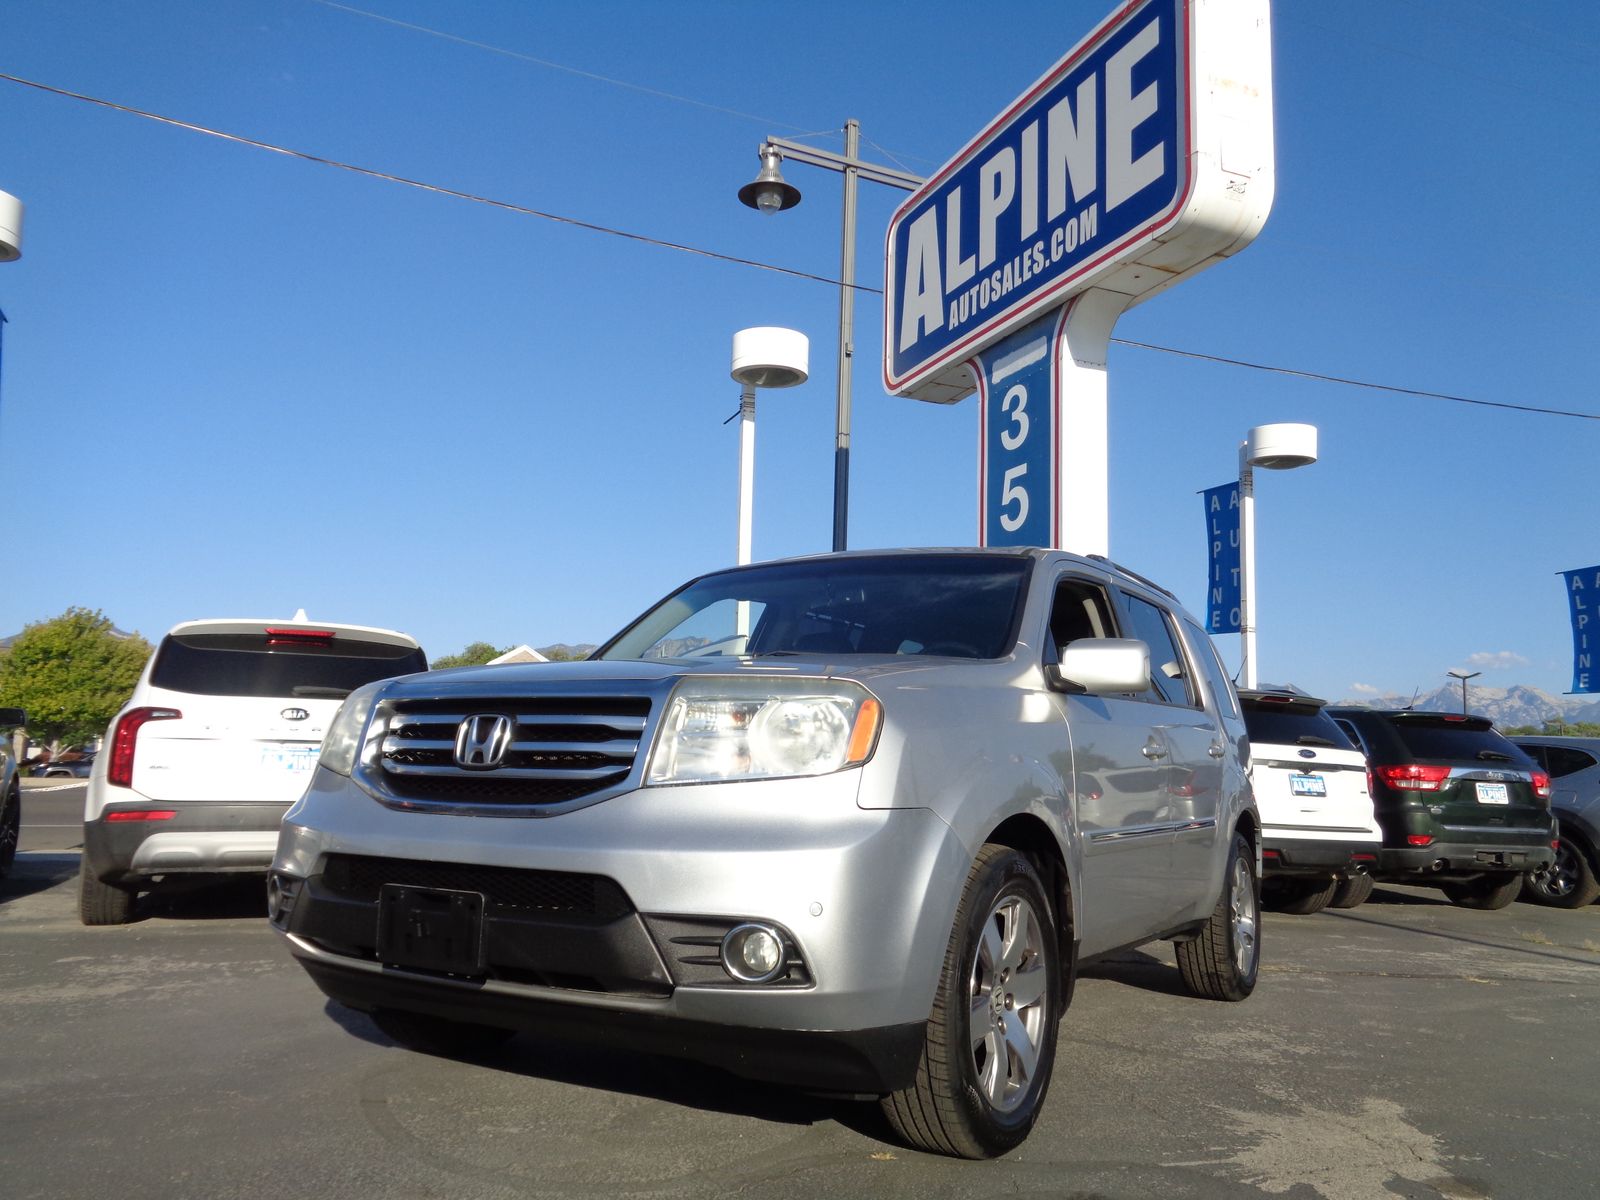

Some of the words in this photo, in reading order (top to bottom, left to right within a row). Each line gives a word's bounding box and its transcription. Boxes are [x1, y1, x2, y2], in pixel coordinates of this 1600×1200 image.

[900, 16, 1164, 353] ALPINE
[949, 202, 1097, 331] AUTOSALES.COM
[1211, 495, 1222, 627] ALPINE
[1229, 491, 1241, 626] AUTO
[1572, 575, 1591, 688] ALPINE
[1480, 788, 1506, 801] ALPINE
